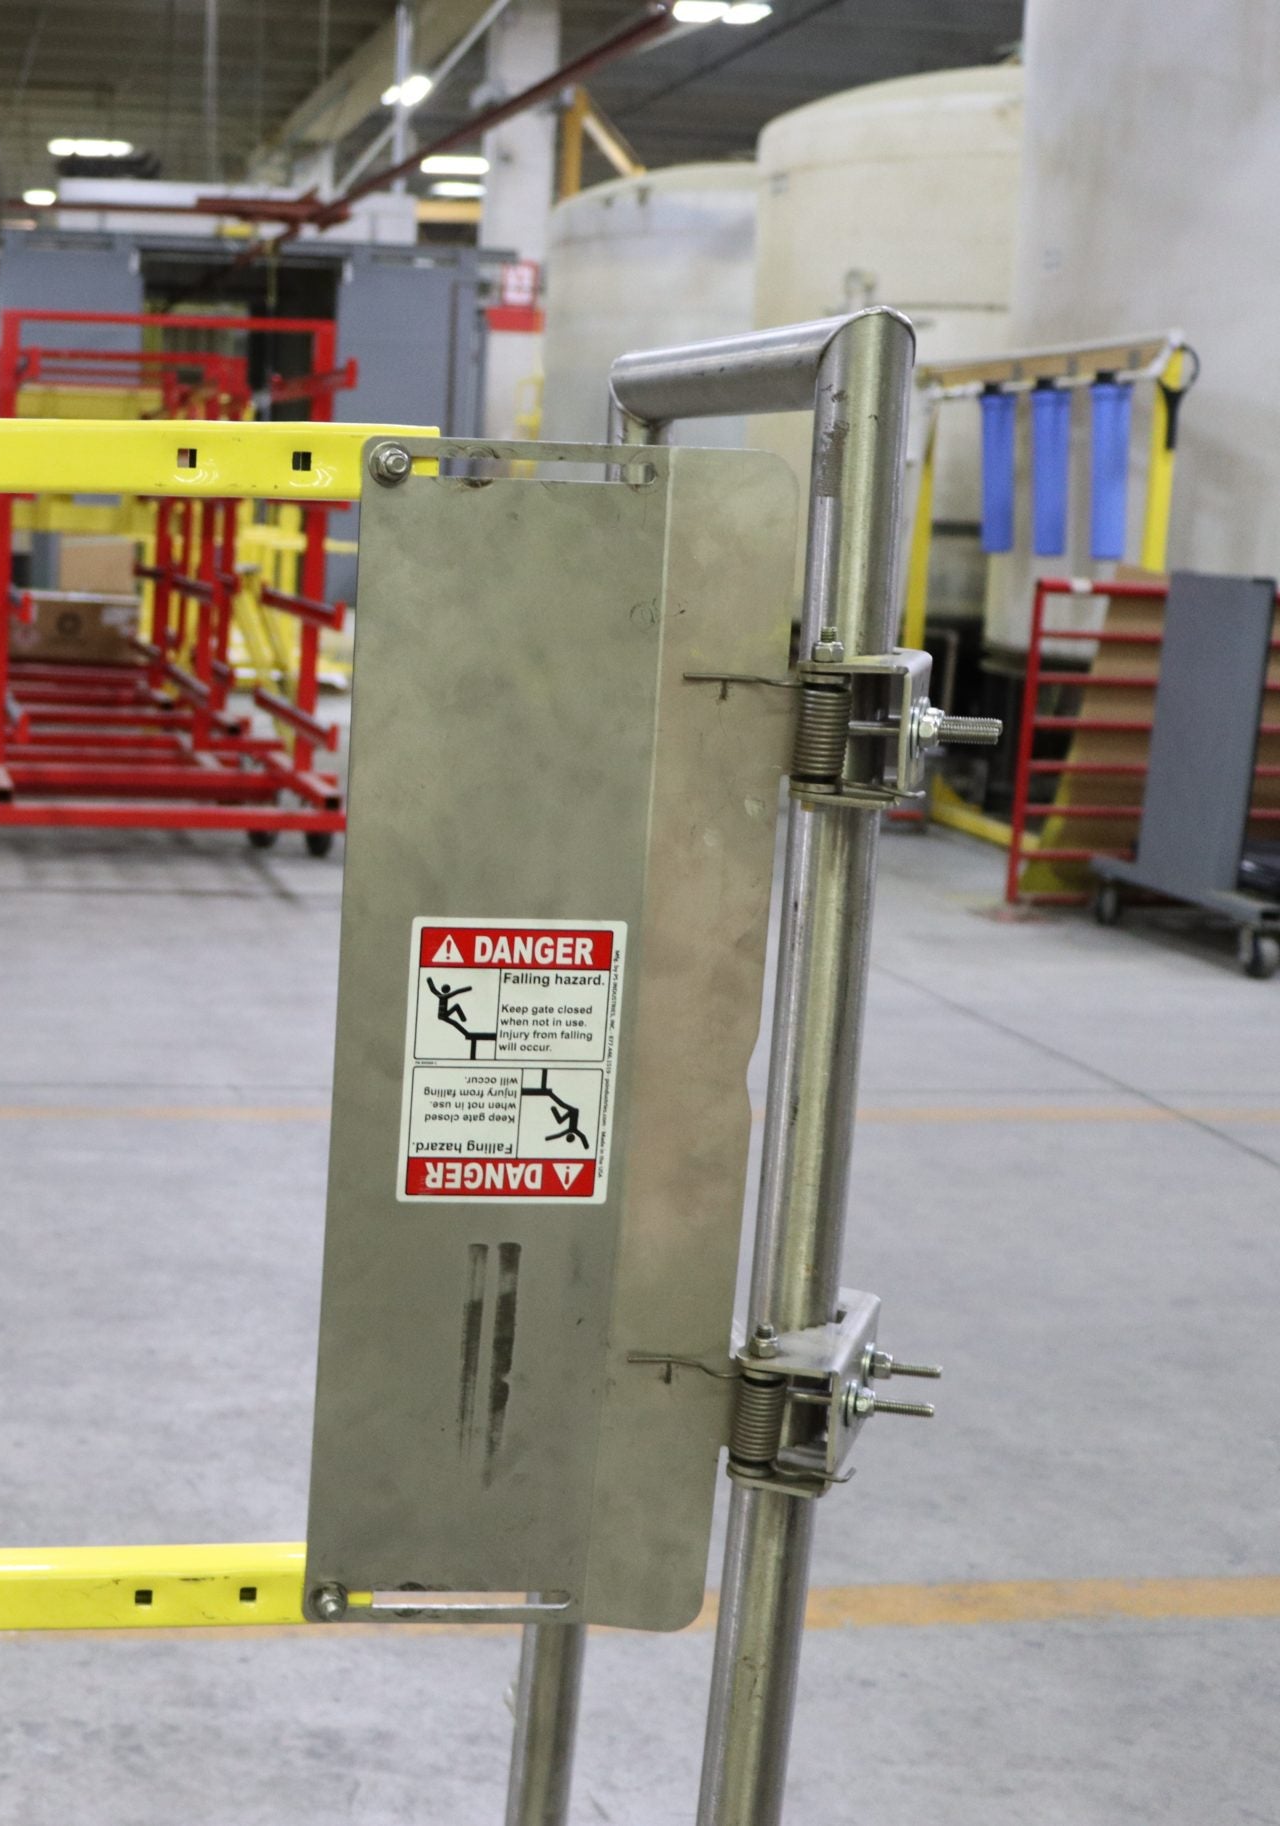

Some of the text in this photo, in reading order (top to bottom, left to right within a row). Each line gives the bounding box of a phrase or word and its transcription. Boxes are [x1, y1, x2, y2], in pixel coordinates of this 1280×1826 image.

[474, 935, 593, 965] DANGER
[503, 972, 605, 988] Falling hazard.
[501, 1004, 593, 1015] Keep gate closed
[500, 1017, 587, 1027] when not in use.
[499, 1030, 593, 1041] Injury from falling
[498, 1042, 552, 1052] will occur.
[465, 1076, 518, 1086] will occur.
[424, 1087, 517, 1098] Injury from falling
[454, 1102, 464, 1110] in
[467, 1101, 485, 1109] not
[488, 1102, 516, 1111] when
[424, 1112, 515, 1124] Keep gate closed
[412, 1140, 513, 1154] Falling hazard.
[425, 1162, 543, 1190] DANGER
